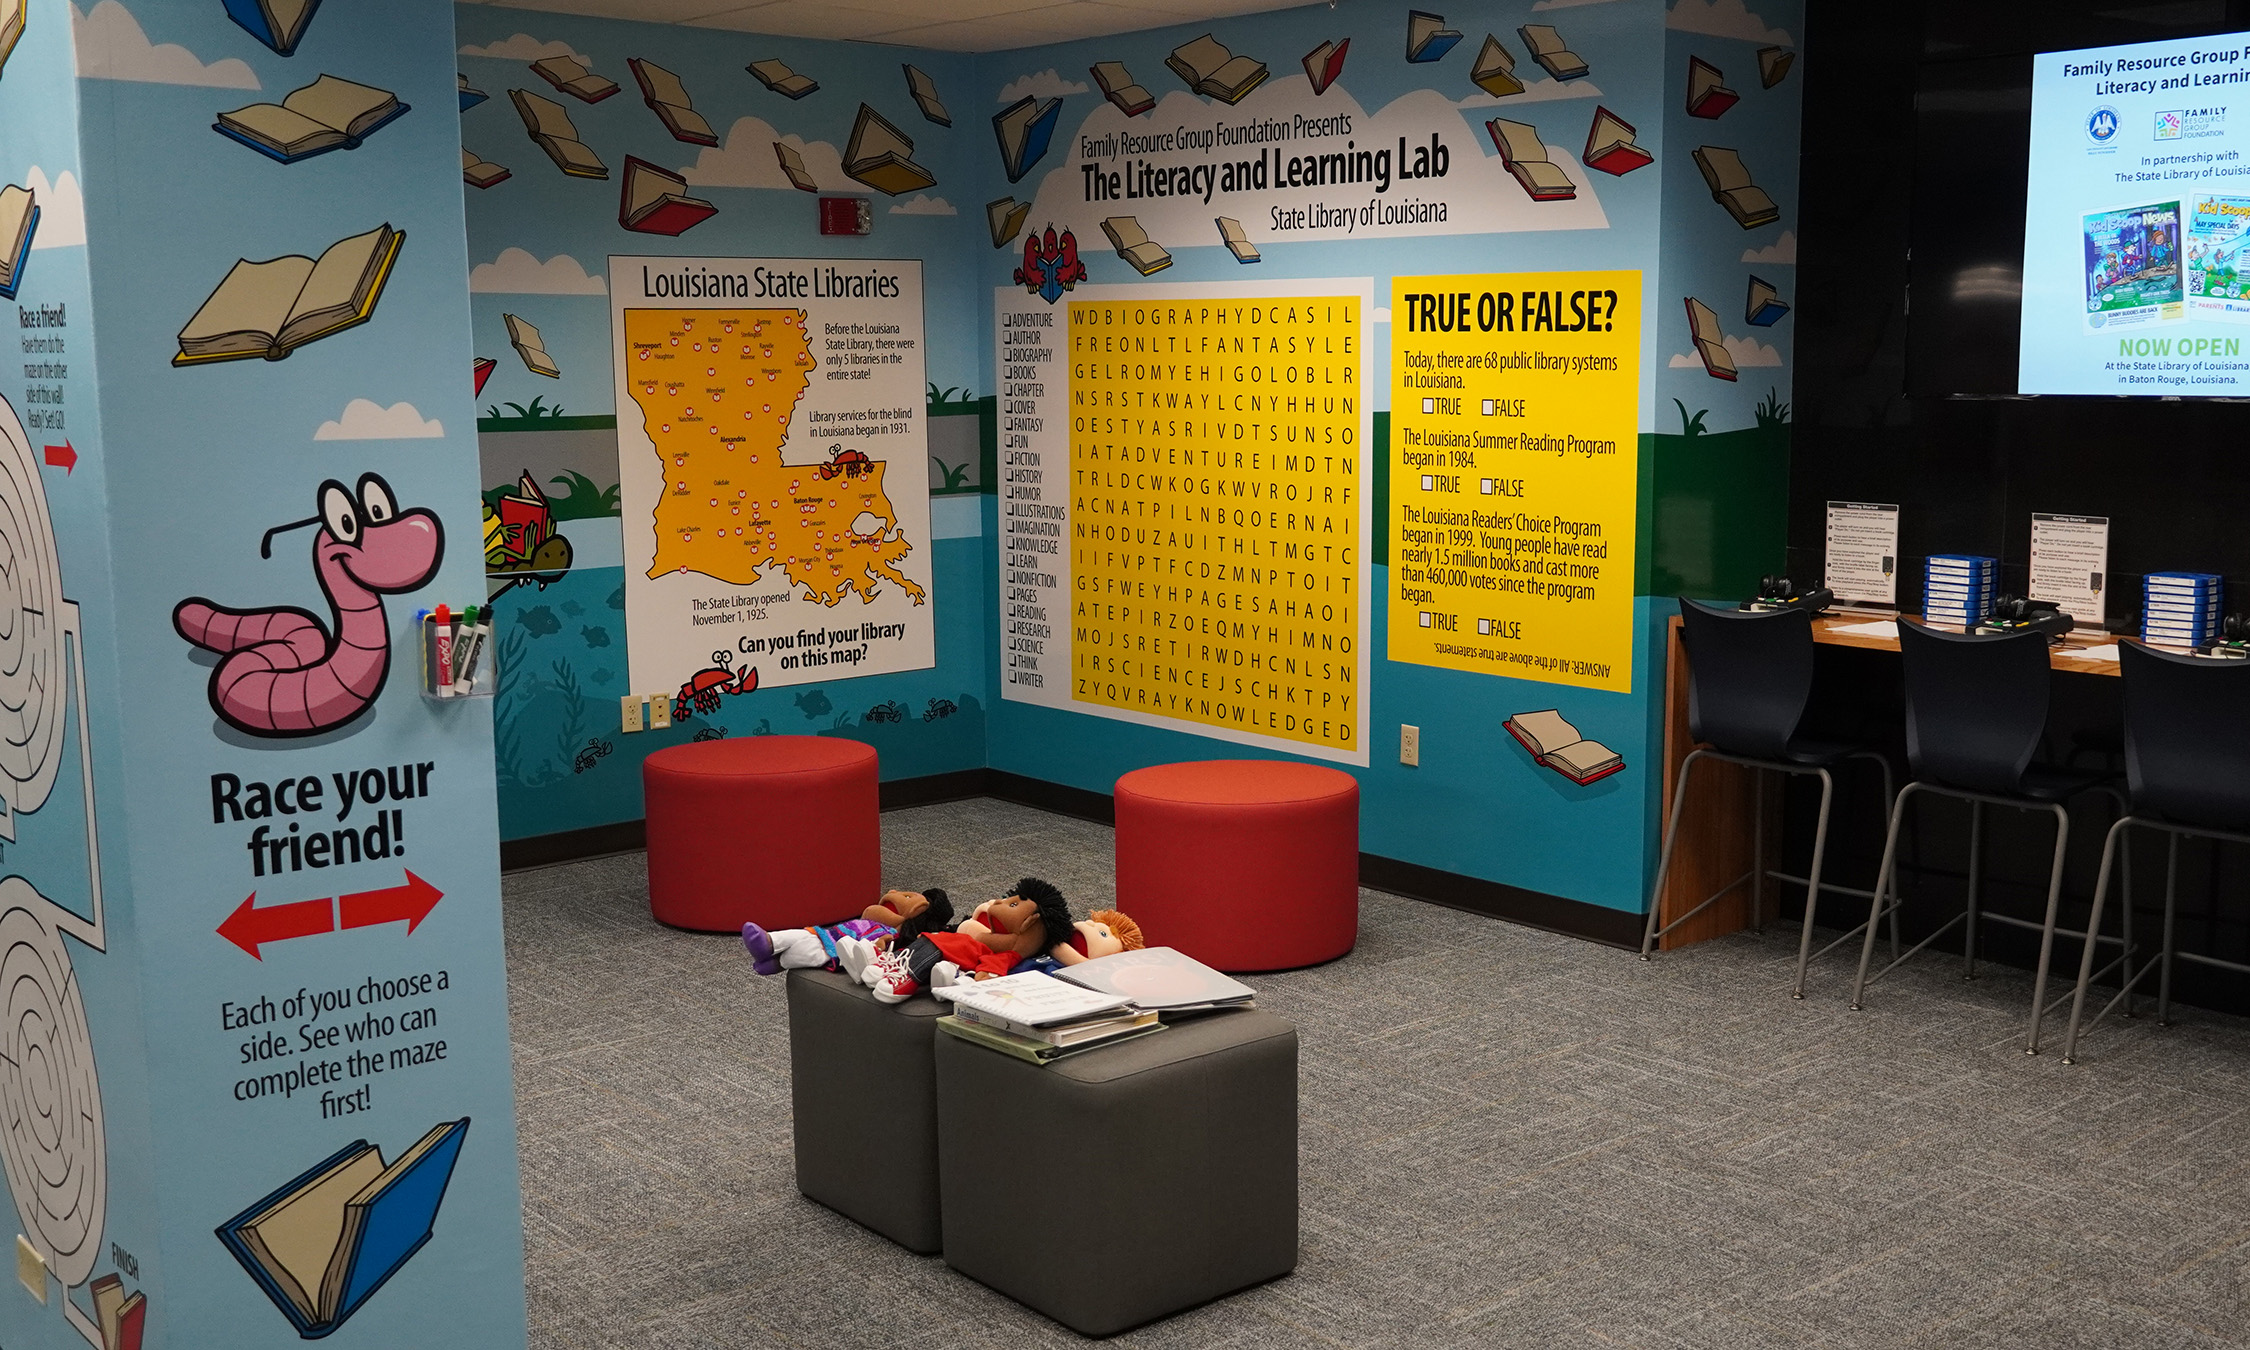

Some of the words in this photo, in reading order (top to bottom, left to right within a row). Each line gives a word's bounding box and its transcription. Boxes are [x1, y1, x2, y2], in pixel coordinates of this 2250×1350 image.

[2064, 60, 2112, 77] Family
[2117, 56, 2186, 72] Resource
[2191, 50, 2239, 64] Group
[2097, 80, 2156, 95] Literacy
[2161, 74, 2189, 89] and
[2185, 107, 2226, 117] FAMILY
[1082, 133, 1118, 162] Family
[1121, 132, 1173, 155] Resource
[1176, 126, 1213, 154] Group
[1217, 118, 1290, 146] Foundation
[1294, 113, 1351, 139] Presents
[2184, 130, 2224, 138] FOUNDATION
[2142, 157, 2150, 166] In
[2154, 152, 2213, 167] partnership
[2216, 150, 2238, 160] with
[1081, 163, 1120, 201] The
[1126, 159, 1216, 205] Literacy
[1221, 148, 1267, 192] and
[1275, 140, 1391, 193] Learning
[1399, 133, 1449, 179] Lab
[1271, 206, 1305, 230] State
[1309, 202, 1356, 233] Library
[1360, 199, 1376, 226] of
[1378, 198, 1447, 225] Louisiana
[2142, 212, 2177, 226] News
[644, 266, 748, 297] Louisiana
[754, 267, 808, 297] State
[814, 267, 899, 298] Libraries
[19, 305, 36, 328] Race
[36, 311, 41, 328] a
[41, 302, 66, 328] friend!
[1405, 293, 1470, 332] TRUE
[1478, 292, 1514, 332] OR
[1522, 290, 1617, 332] FALSE?
[825, 323, 850, 334] Before
[851, 323, 864, 334] the
[865, 323, 900, 334] Louisiana
[1012, 313, 1053, 327] ADVENTURE
[634, 342, 662, 350] Shreveport
[826, 338, 845, 350] State
[847, 338, 874, 352] Library,
[876, 338, 895, 349] there
[896, 340, 914, 348] were
[1013, 331, 1041, 344] AUTHOR
[1013, 348, 1052, 362] BIOGRAPHY
[2120, 339, 2171, 356] NOW
[2178, 338, 2239, 356] OPEN
[1404, 350, 1434, 372] Today,
[1437, 351, 1464, 368] there
[1466, 356, 1482, 368] are
[1484, 352, 1498, 369] 68
[1500, 351, 1532, 373] public
[1535, 351, 1570, 374] library
[1572, 354, 1617, 375] systems
[827, 369, 849, 380] entire
[850, 368, 870, 380] state!
[1014, 366, 1036, 380] BOOKS
[2129, 375, 2155, 383] Baton
[2158, 375, 2188, 386] Rouge,
[2191, 375, 2238, 384] Louisiana.
[1014, 383, 1044, 397] CHAPTER
[1014, 400, 1035, 414] COVER
[1435, 398, 1461, 415] TRUE
[1495, 399, 1525, 417] FALSE
[1014, 417, 1043, 432] FANTASY
[1014, 435, 1028, 448] FUN
[1403, 428, 1421, 445] The
[1424, 429, 1470, 448] Louisiana
[1473, 430, 1518, 450] Summer
[1520, 432, 1564, 457] Reading
[1568, 434, 1615, 458] Program
[1015, 452, 1040, 466] FICTION
[1015, 469, 1042, 484] HISTORY
[1015, 486, 1041, 501] HUMOR
[1434, 475, 1460, 493] TRUE
[1494, 478, 1524, 497] FALSE
[1015, 503, 1065, 520] ILLUSTRATIONS
[748, 519, 771, 527] Lafayette
[1016, 520, 1060, 537] IMAGINATION
[1402, 505, 1420, 523] The
[1423, 506, 1469, 526] Louisiana
[1472, 510, 1515, 530] Readers'
[1516, 513, 1551, 533] Choice
[1554, 516, 1601, 540] Program
[1016, 537, 1058, 554] KNOWLEDGE
[1016, 554, 1037, 569] LEARN
[1016, 571, 1056, 588] NONFICTION
[692, 599, 707, 610] The
[709, 598, 730, 609] State
[732, 595, 759, 608] Library
[760, 590, 790, 606] opened
[1017, 588, 1037, 603] PAGES
[1017, 604, 1046, 621] READING
[1017, 621, 1050, 638] RESEARCH
[1432, 612, 1458, 632] TRUE
[1491, 619, 1521, 640] FALSE
[738, 636, 765, 653] Can
[768, 636, 794, 655] you
[796, 628, 825, 647] find
[828, 628, 859, 648] your
[862, 622, 905, 641] library
[1017, 638, 1043, 655] SCIENCE
[781, 656, 798, 669] on
[801, 649, 828, 667] this
[831, 643, 868, 666] map?
[1434, 643, 1477, 658] statements.
[1478, 648, 1494, 661] true
[1496, 651, 1508, 661] are
[1018, 654, 1038, 670] THINK
[1509, 652, 1533, 668] above
[1534, 656, 1548, 670] the
[1549, 658, 1558, 671] of
[1560, 659, 1570, 672] All
[1572, 661, 1610, 678] ANSWER:
[1018, 671, 1043, 688] WRITER
[211, 773, 323, 824] Race
[332, 761, 434, 822] your
[248, 809, 404, 877] friend!
[222, 996, 276, 1030] Each
[282, 988, 306, 1018] of
[310, 988, 351, 1022] you
[357, 974, 432, 1004] choose
[438, 971, 449, 990] a
[240, 1031, 293, 1064] side.
[299, 1024, 340, 1052] See
[344, 1012, 394, 1042] who
[400, 1008, 436, 1032] can
[234, 1060, 342, 1100] complete
[346, 1050, 384, 1078] the
[390, 1040, 447, 1069] maze
[320, 1084, 370, 1119] first!
[112, 1242, 139, 1282] FINISH
